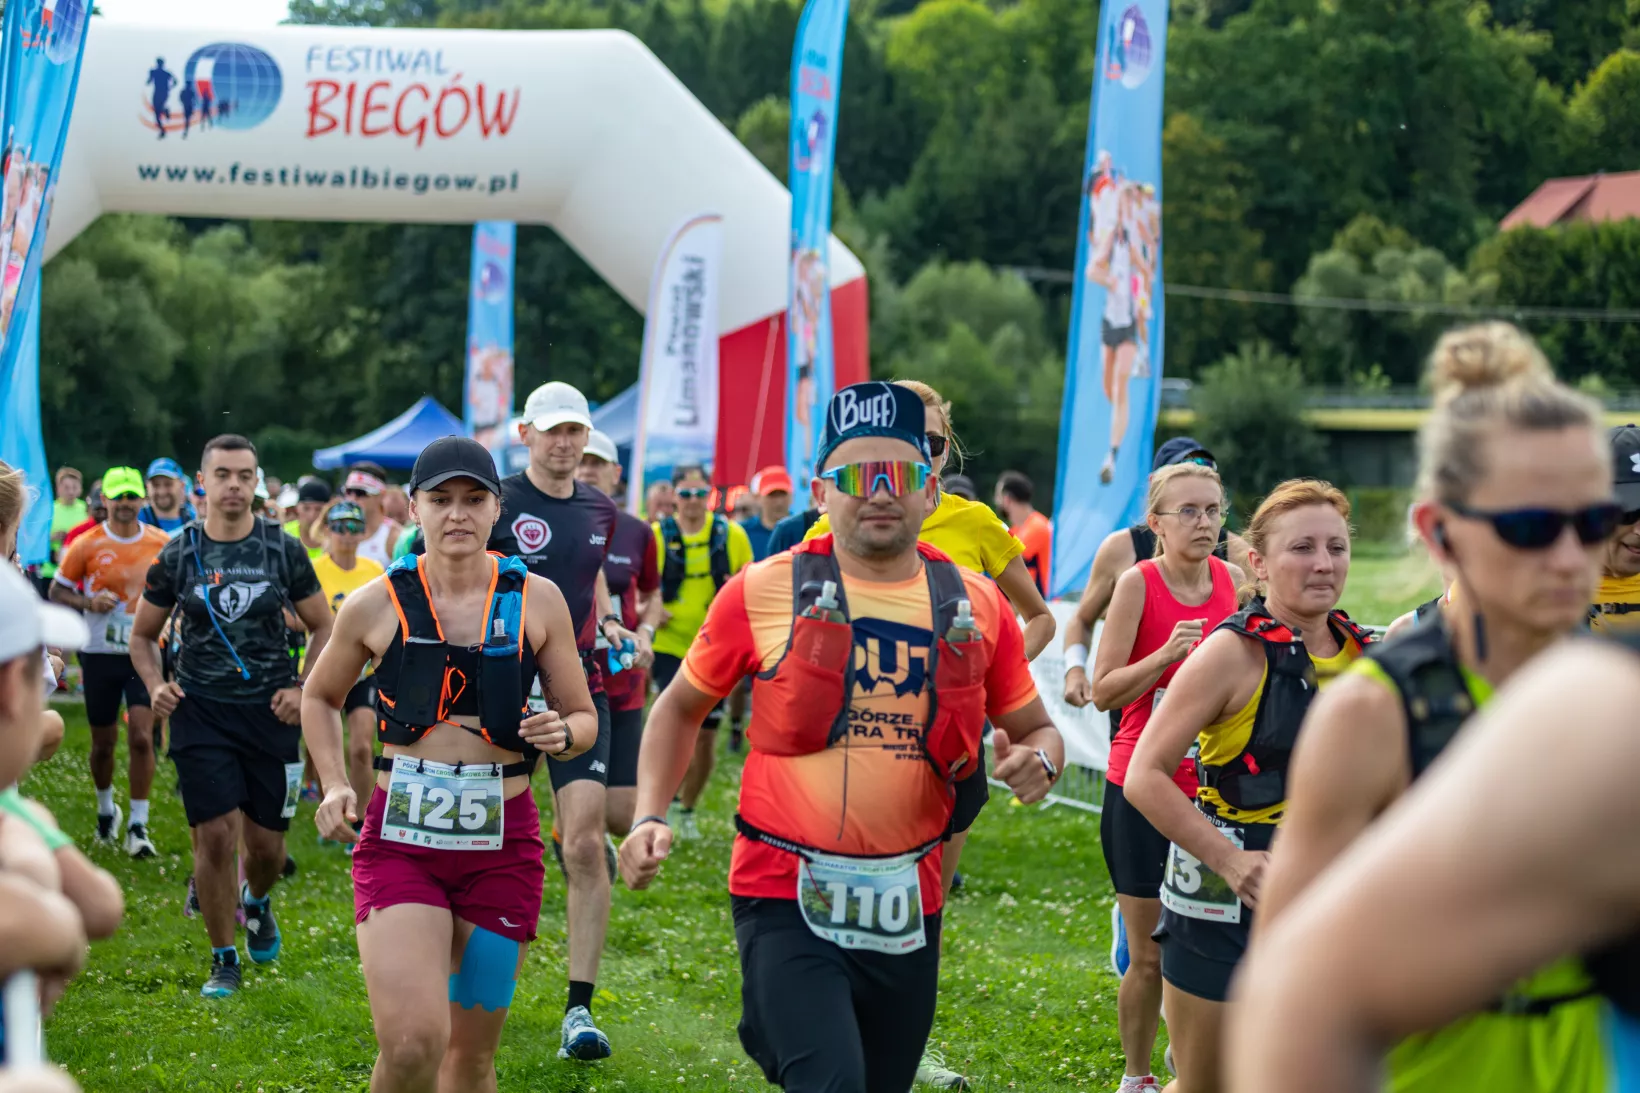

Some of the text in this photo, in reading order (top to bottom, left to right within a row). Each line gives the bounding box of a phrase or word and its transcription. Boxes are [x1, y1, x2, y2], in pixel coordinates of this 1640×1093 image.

[306, 46, 450, 75] FESTIWAL
[305, 73, 521, 149] BIEGÓW
[138, 163, 520, 195] www.festiwalbiegow.pl
[675, 254, 706, 427] Limanowski
[848, 707, 914, 726] GÓRZE
[406, 782, 488, 831] 125
[825, 882, 909, 933] 110
